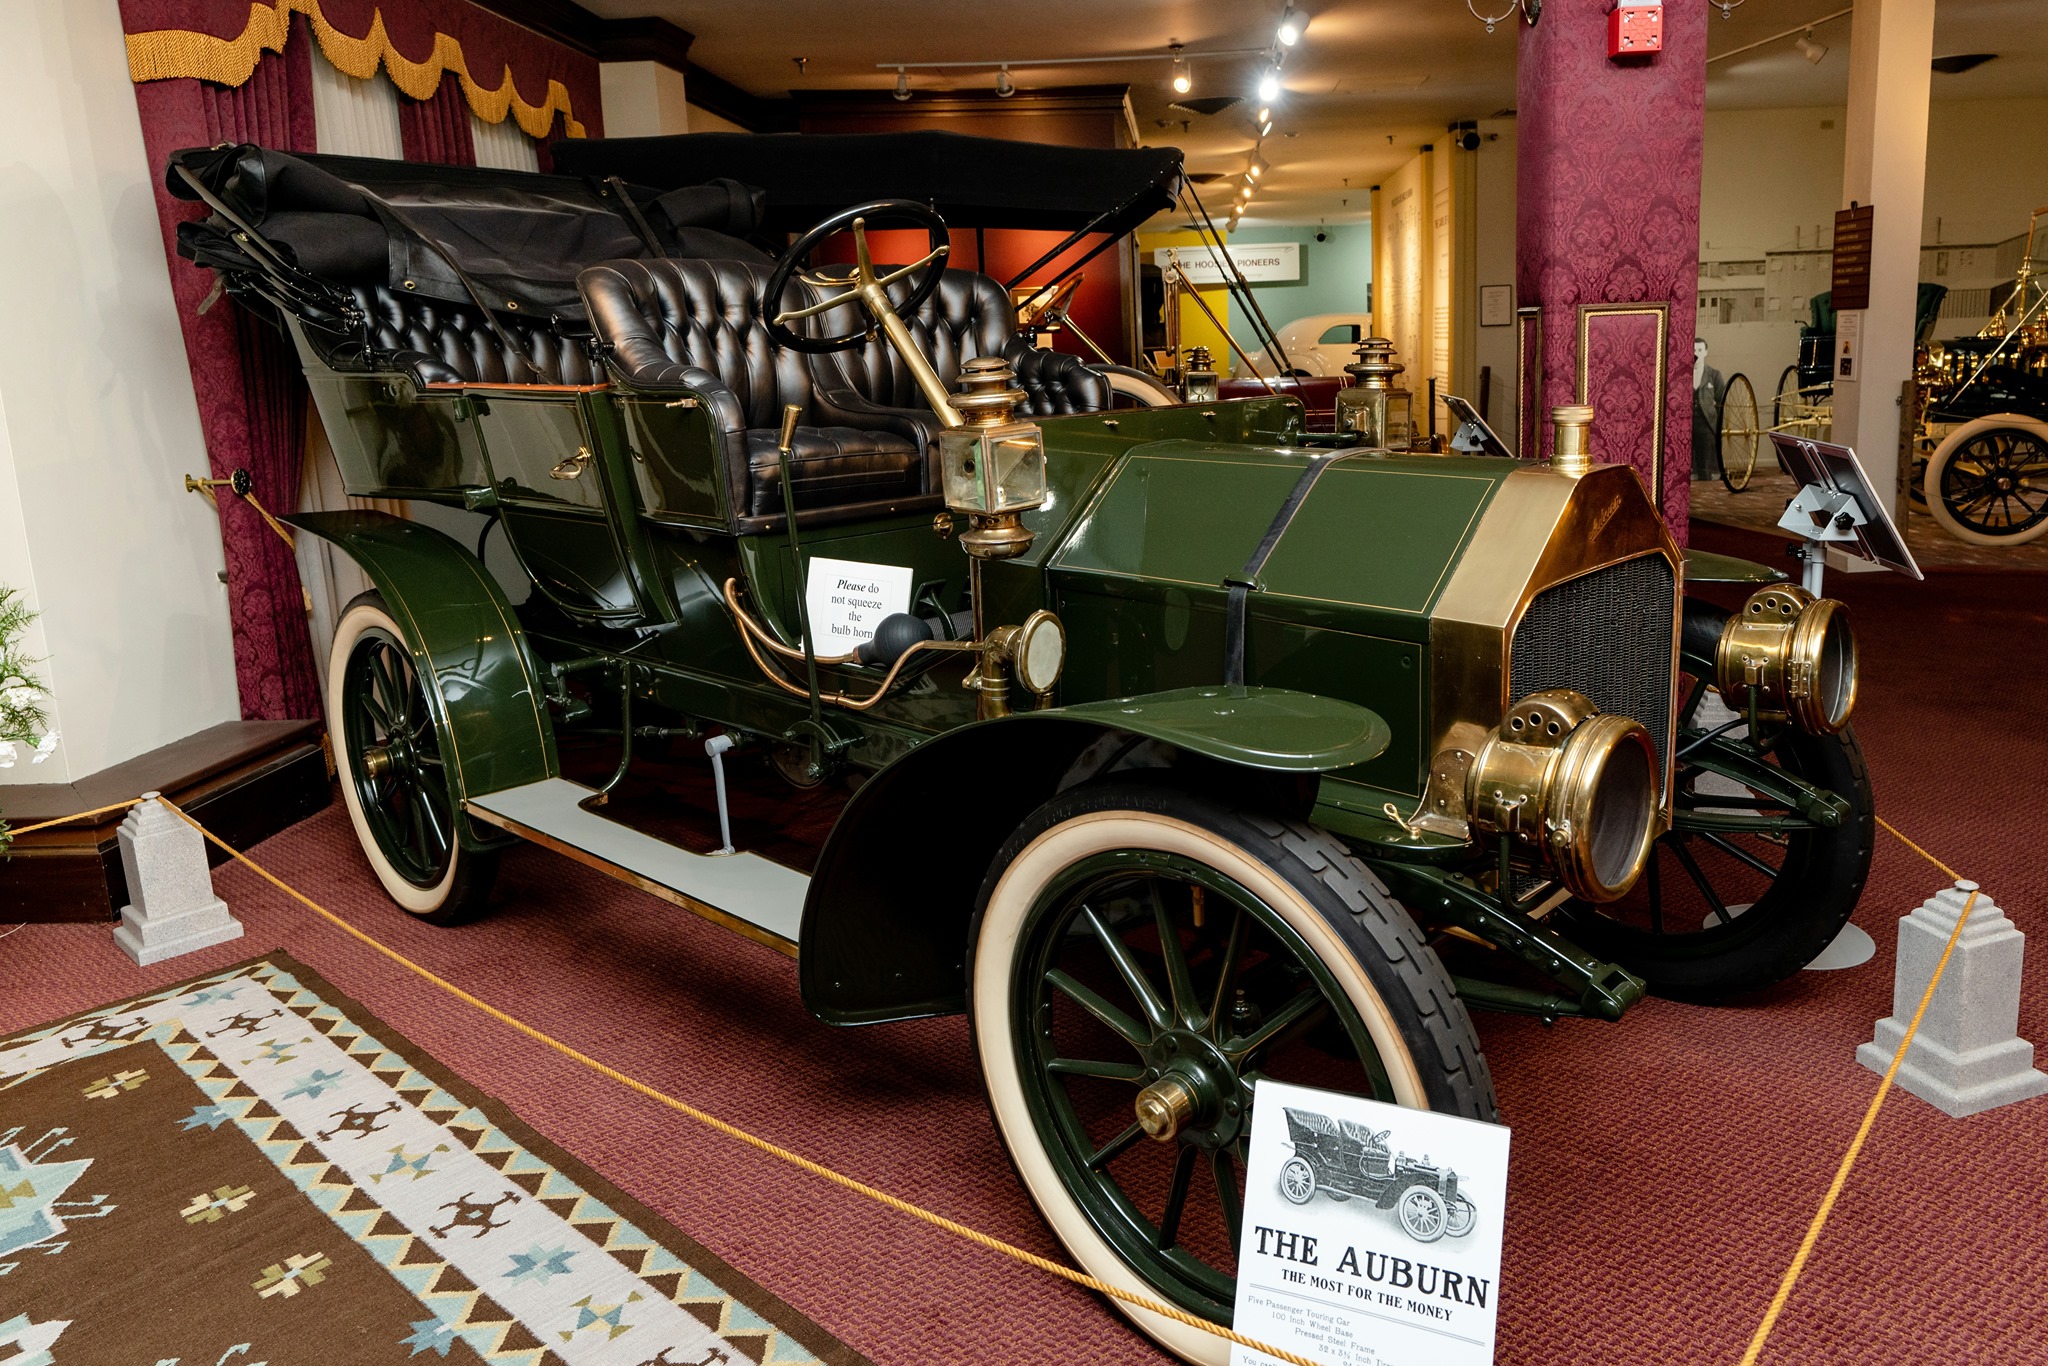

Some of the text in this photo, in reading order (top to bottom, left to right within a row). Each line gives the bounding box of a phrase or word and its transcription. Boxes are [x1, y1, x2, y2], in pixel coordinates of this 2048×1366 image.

[1237, 258, 1280, 267] PIONEERS
[837, 580, 880, 593] Please do
[832, 596, 882, 609] not squeeze
[848, 611, 862, 622] the
[832, 624, 873, 638] bulb horn
[1254, 1226, 1490, 1308] THE AUBURN
[1282, 1268, 1452, 1322] THE MOST FOR THE MONEY
[1248, 1295, 1350, 1327] Five Passenger Touring Car
[1272, 1312, 1354, 1338] 100 Inch Wheel Base
[1295, 1327, 1375, 1355] Pressed Steel Frame
[1243, 1356, 1256, 1365] You
[1319, 1344, 1329, 1353] 32
[1356, 1354, 1371, 1364] Inch
